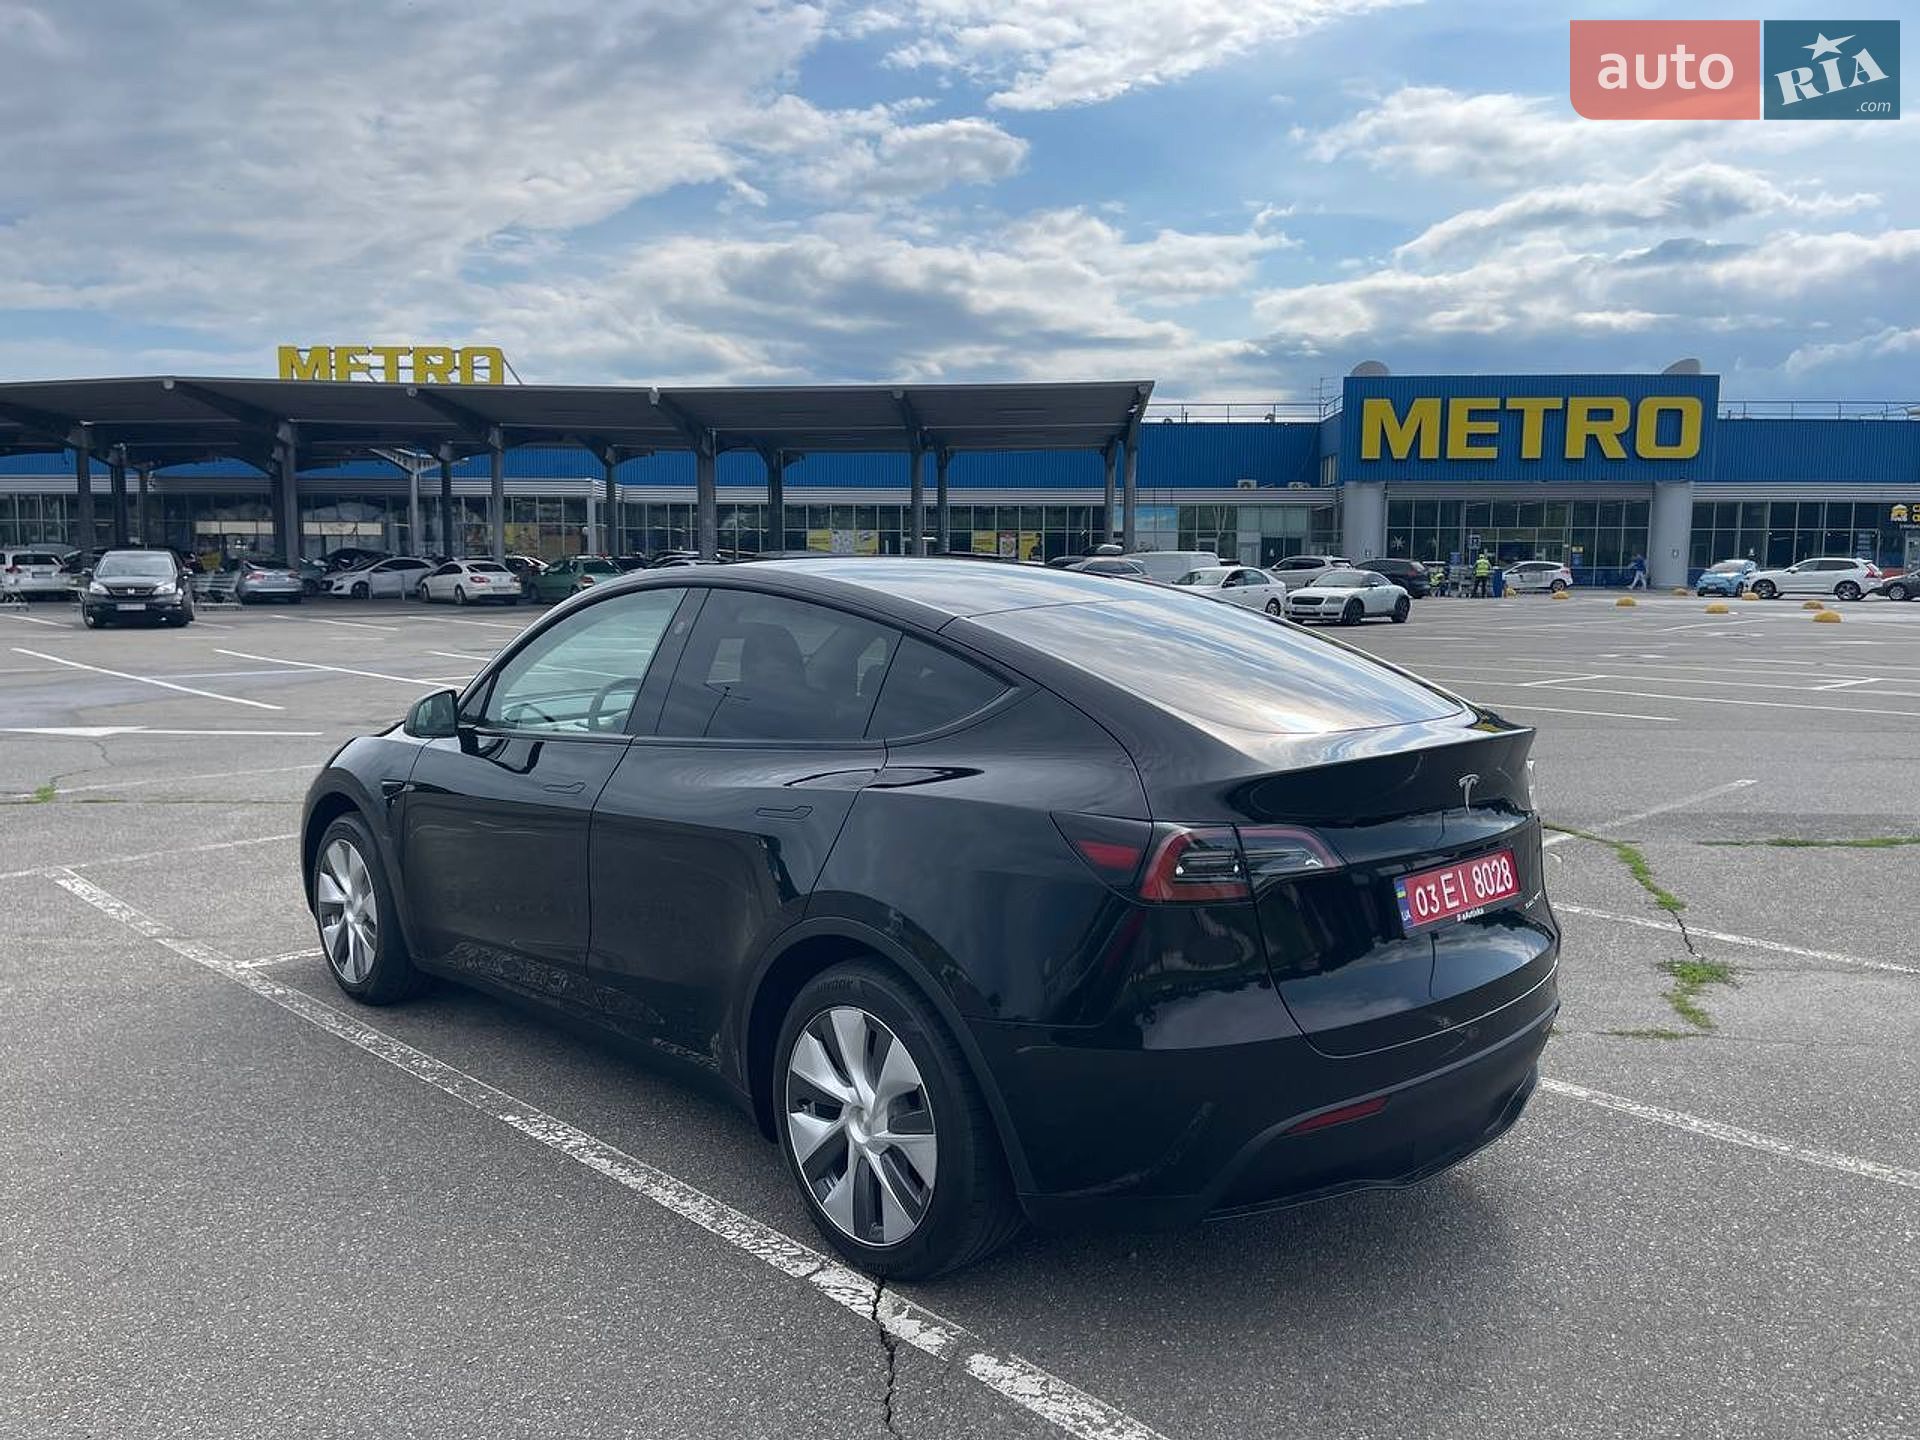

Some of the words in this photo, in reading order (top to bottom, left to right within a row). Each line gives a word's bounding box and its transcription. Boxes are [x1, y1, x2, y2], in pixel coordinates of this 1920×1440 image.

[278, 346, 504, 385] METRO
[1362, 396, 1703, 460] METRO
[1415, 883, 1440, 917] 03
[1440, 869, 1469, 909] EI
[1472, 857, 1513, 898] 8028
